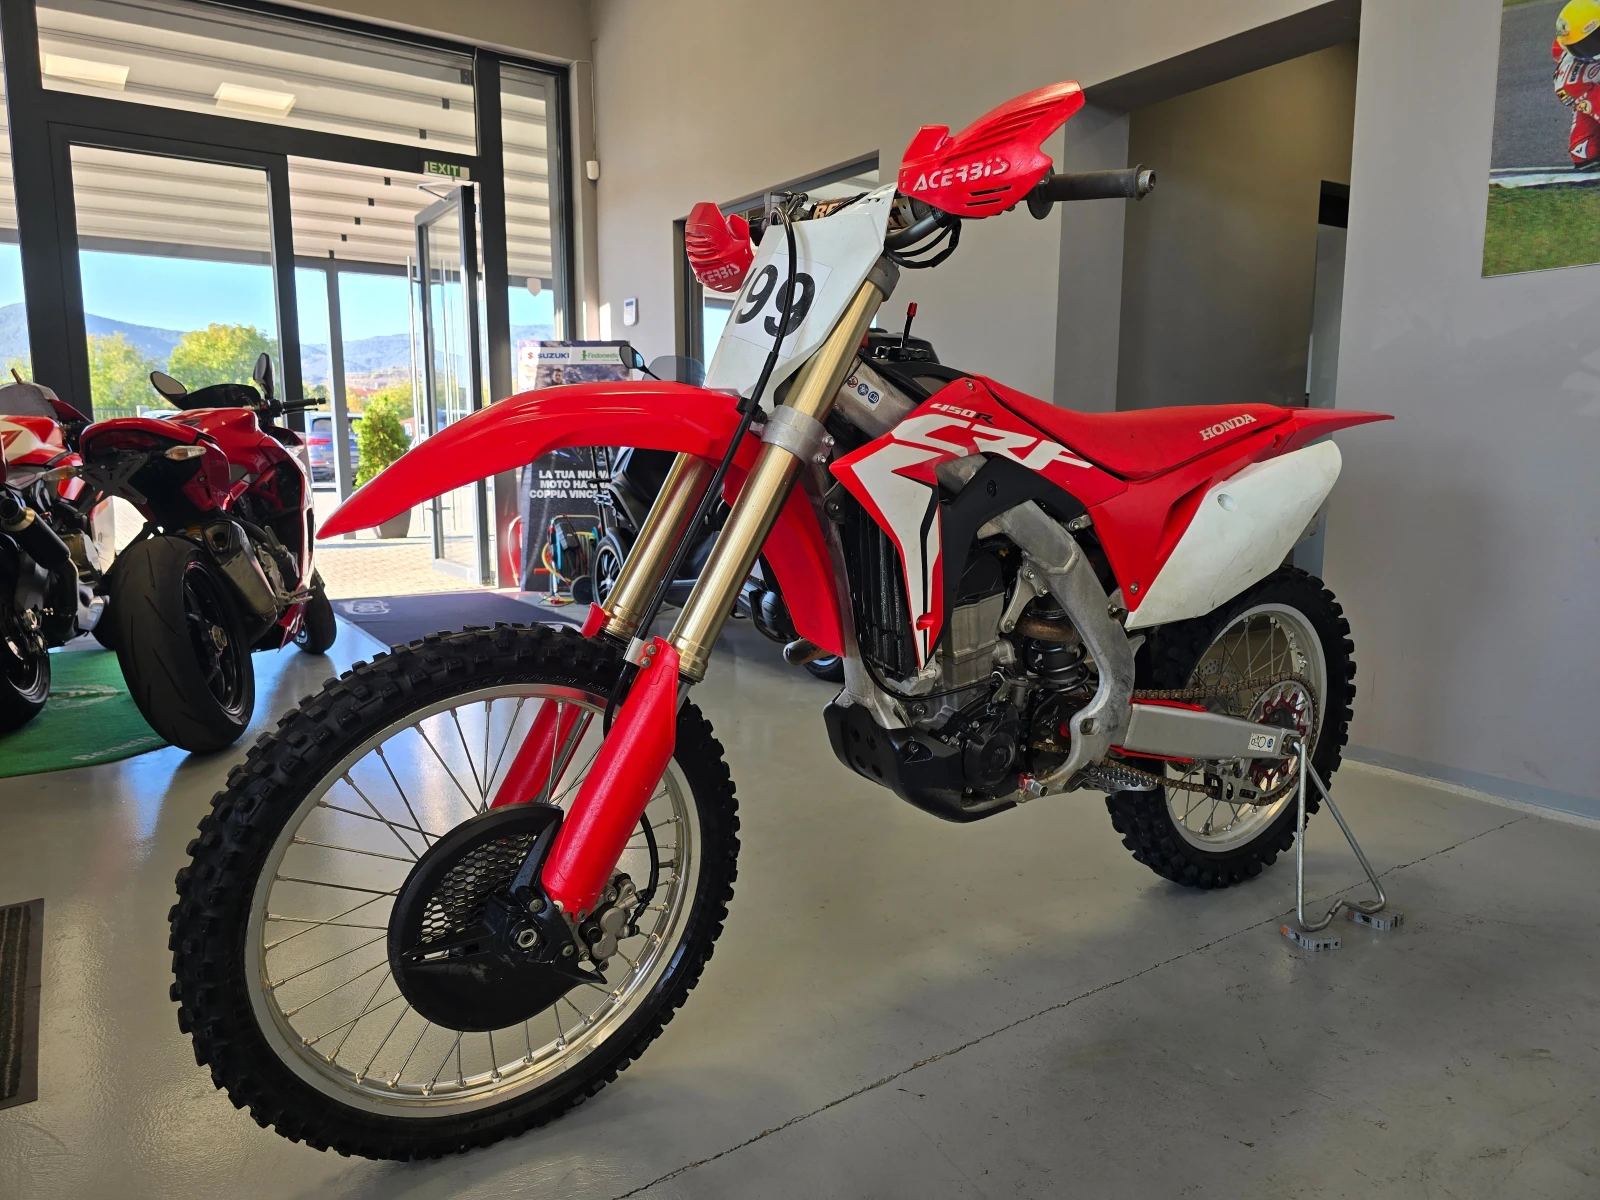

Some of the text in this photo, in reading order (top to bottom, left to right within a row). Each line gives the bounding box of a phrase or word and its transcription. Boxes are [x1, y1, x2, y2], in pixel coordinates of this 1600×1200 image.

[430, 162, 459, 176] EXIT
[700, 263, 741, 283] CERBIS
[930, 403, 995, 425] 450R
[1199, 413, 1257, 441] HONDA
[891, 413, 1094, 470] CRF
[539, 470, 553, 479] LA
[555, 470, 576, 479] TUA
[541, 480, 571, 489] MOTO
[573, 480, 588, 489] HA
[530, 490, 568, 498] COPPIA
